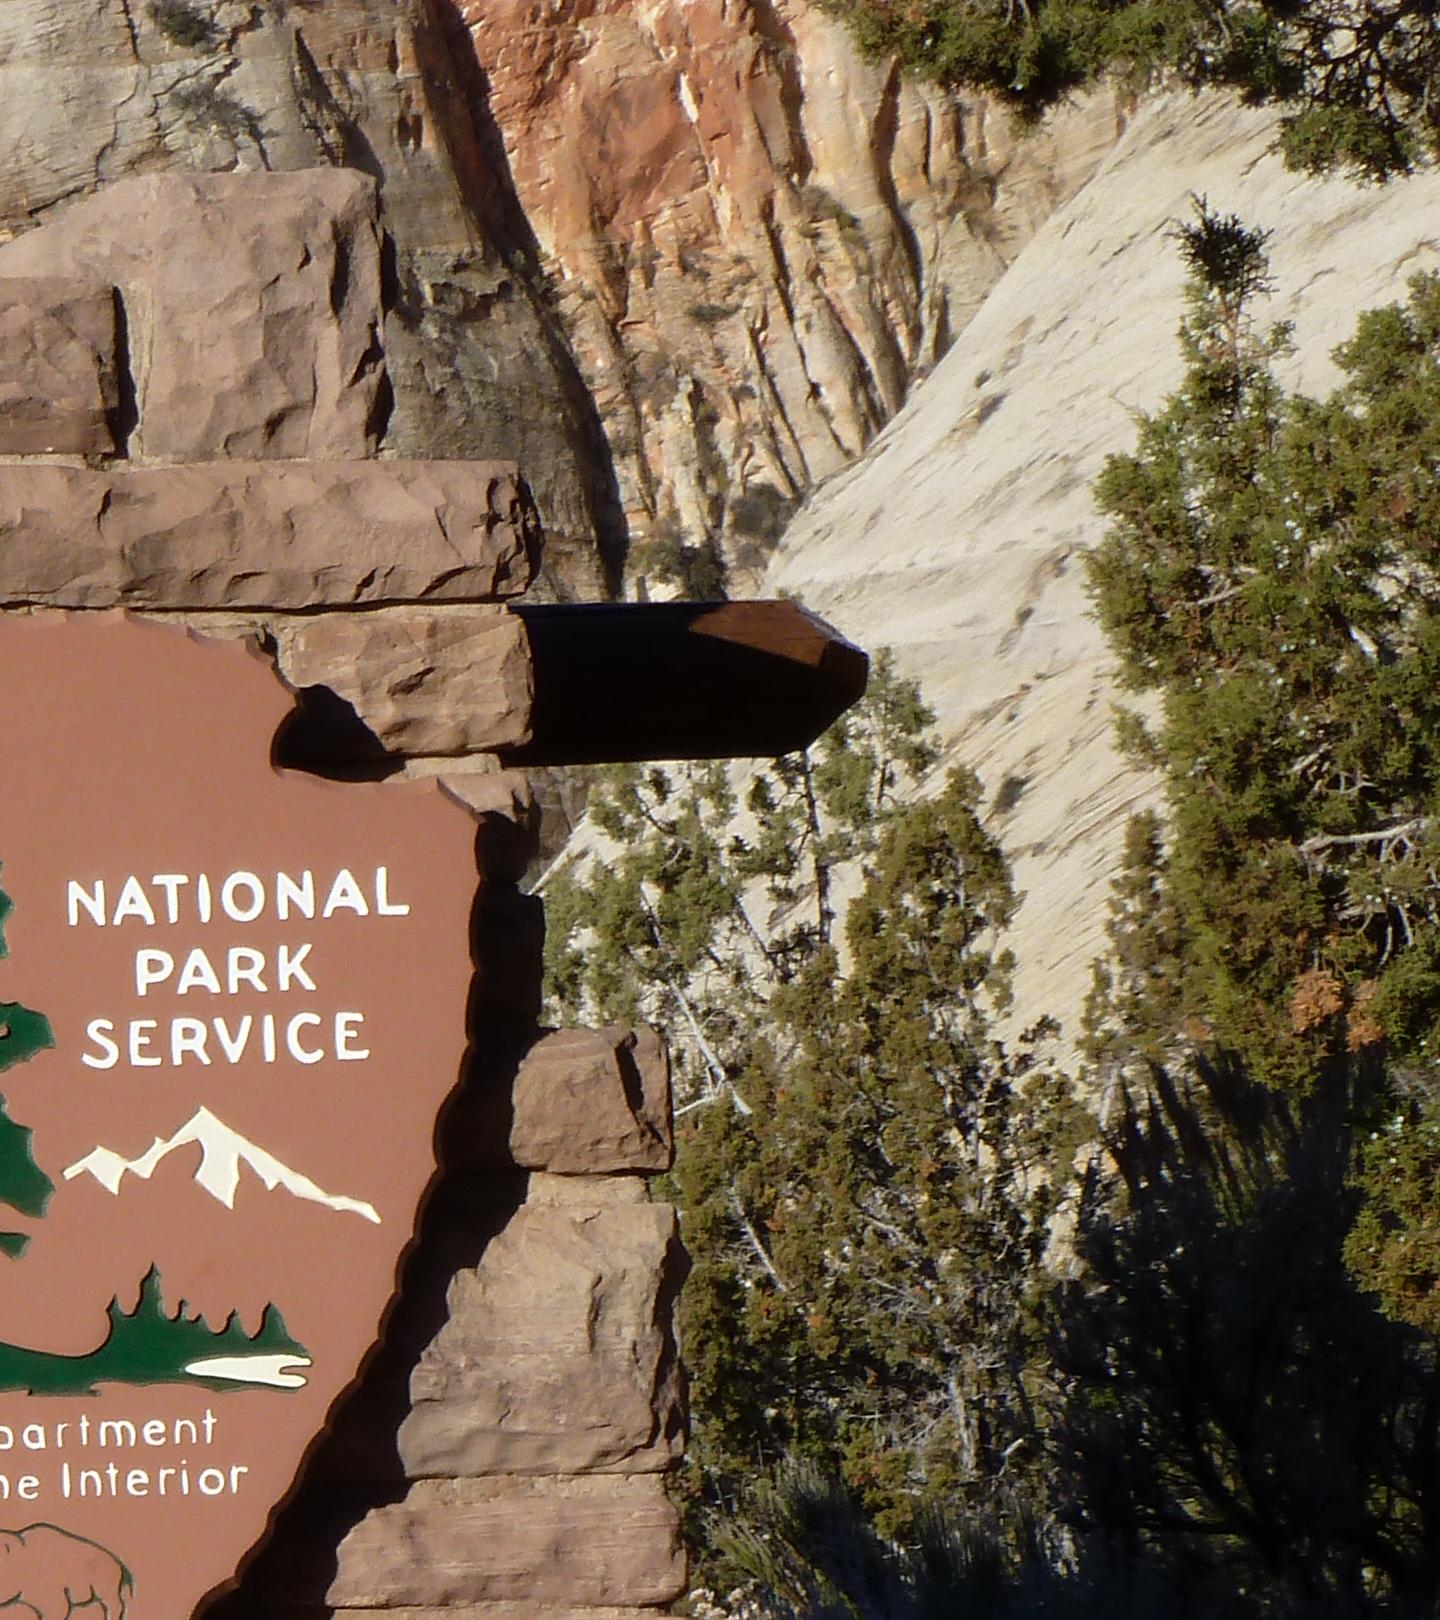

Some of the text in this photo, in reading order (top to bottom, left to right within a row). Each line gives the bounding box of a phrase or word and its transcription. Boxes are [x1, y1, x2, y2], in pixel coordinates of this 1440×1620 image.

[65, 865, 411, 928] NATIONAL
[133, 942, 319, 998] PARK
[80, 1010, 372, 1070] SERVICE
[61, 1460, 250, 1499] Interior
